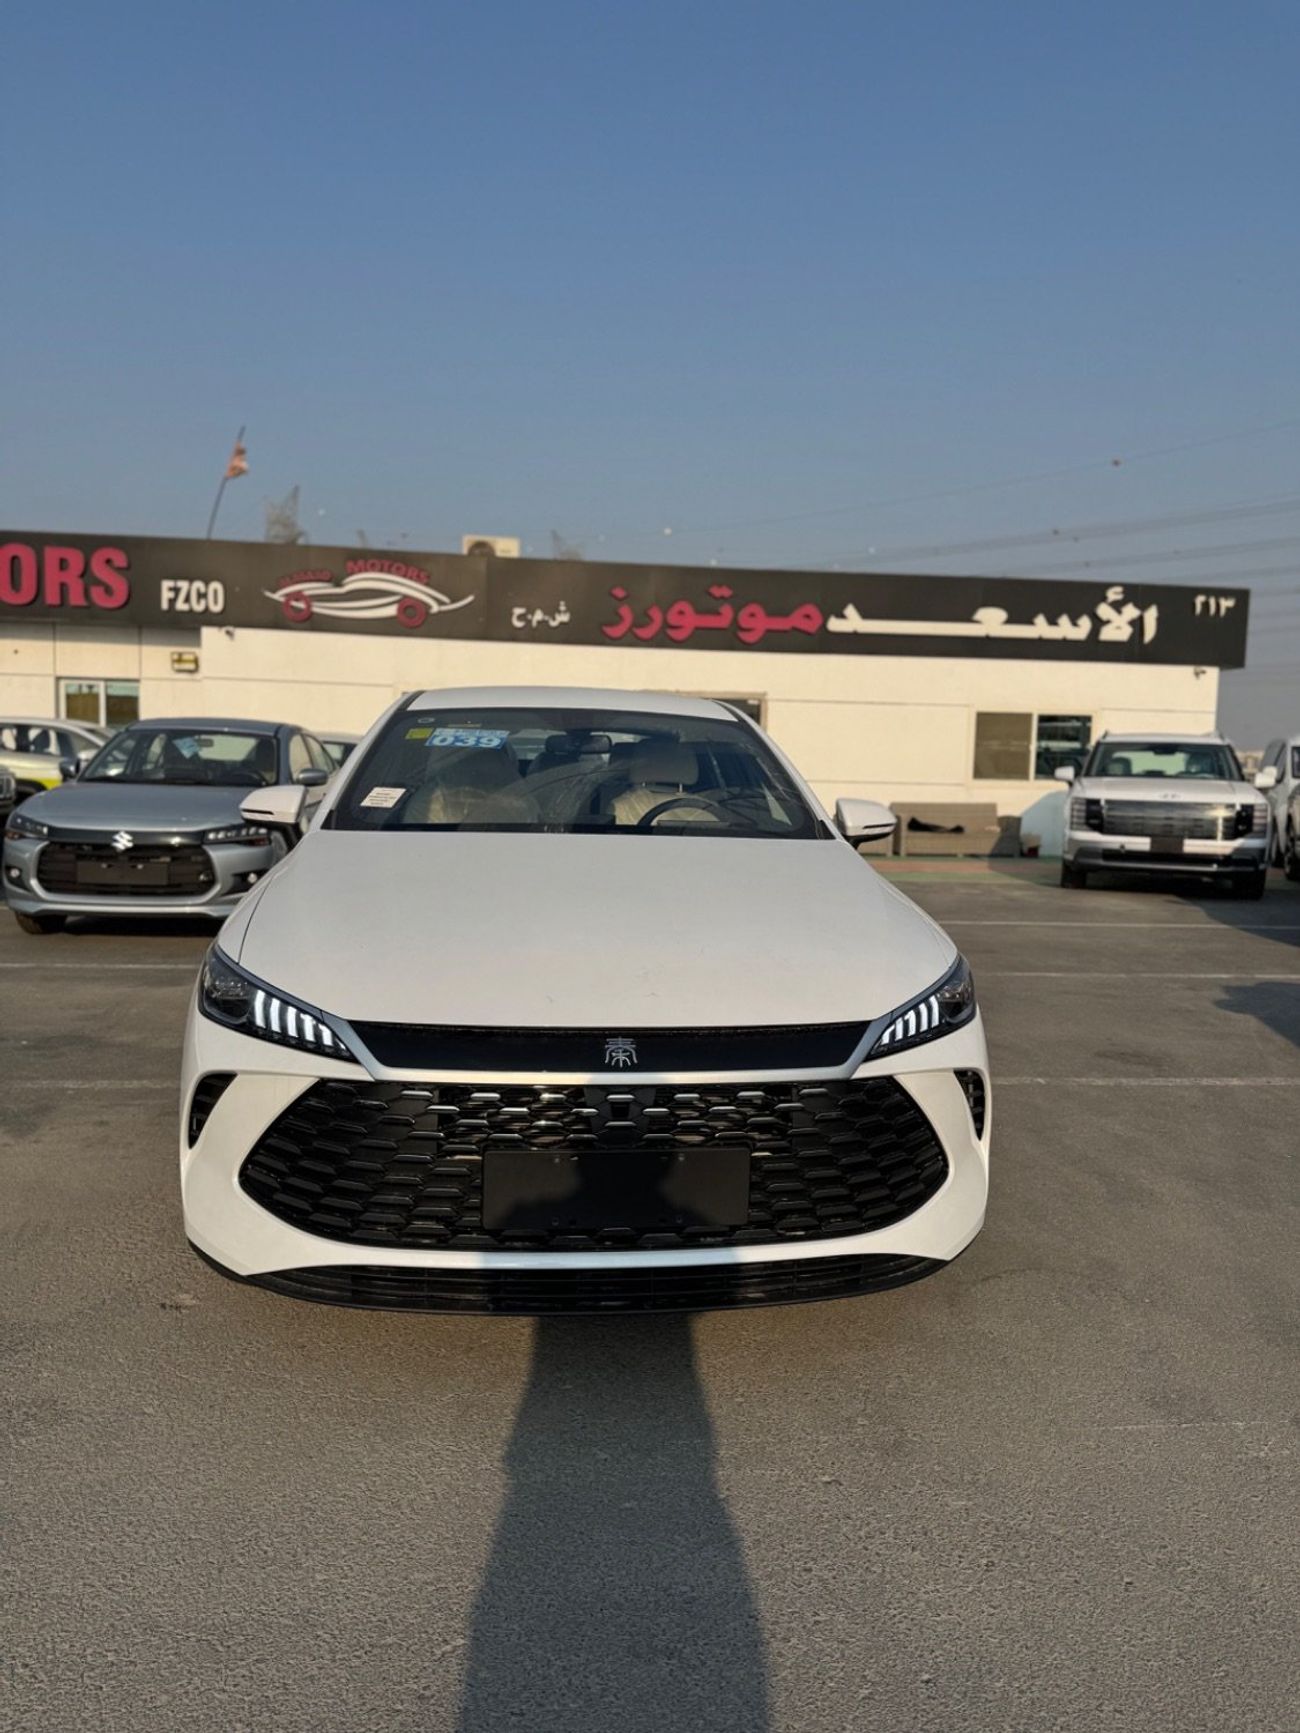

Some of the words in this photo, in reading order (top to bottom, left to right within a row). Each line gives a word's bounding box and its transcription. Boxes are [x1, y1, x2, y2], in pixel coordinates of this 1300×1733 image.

[346, 559, 430, 584] MOTORS
[160, 579, 225, 613] FZCO
[602, 584, 824, 644] موتورز
